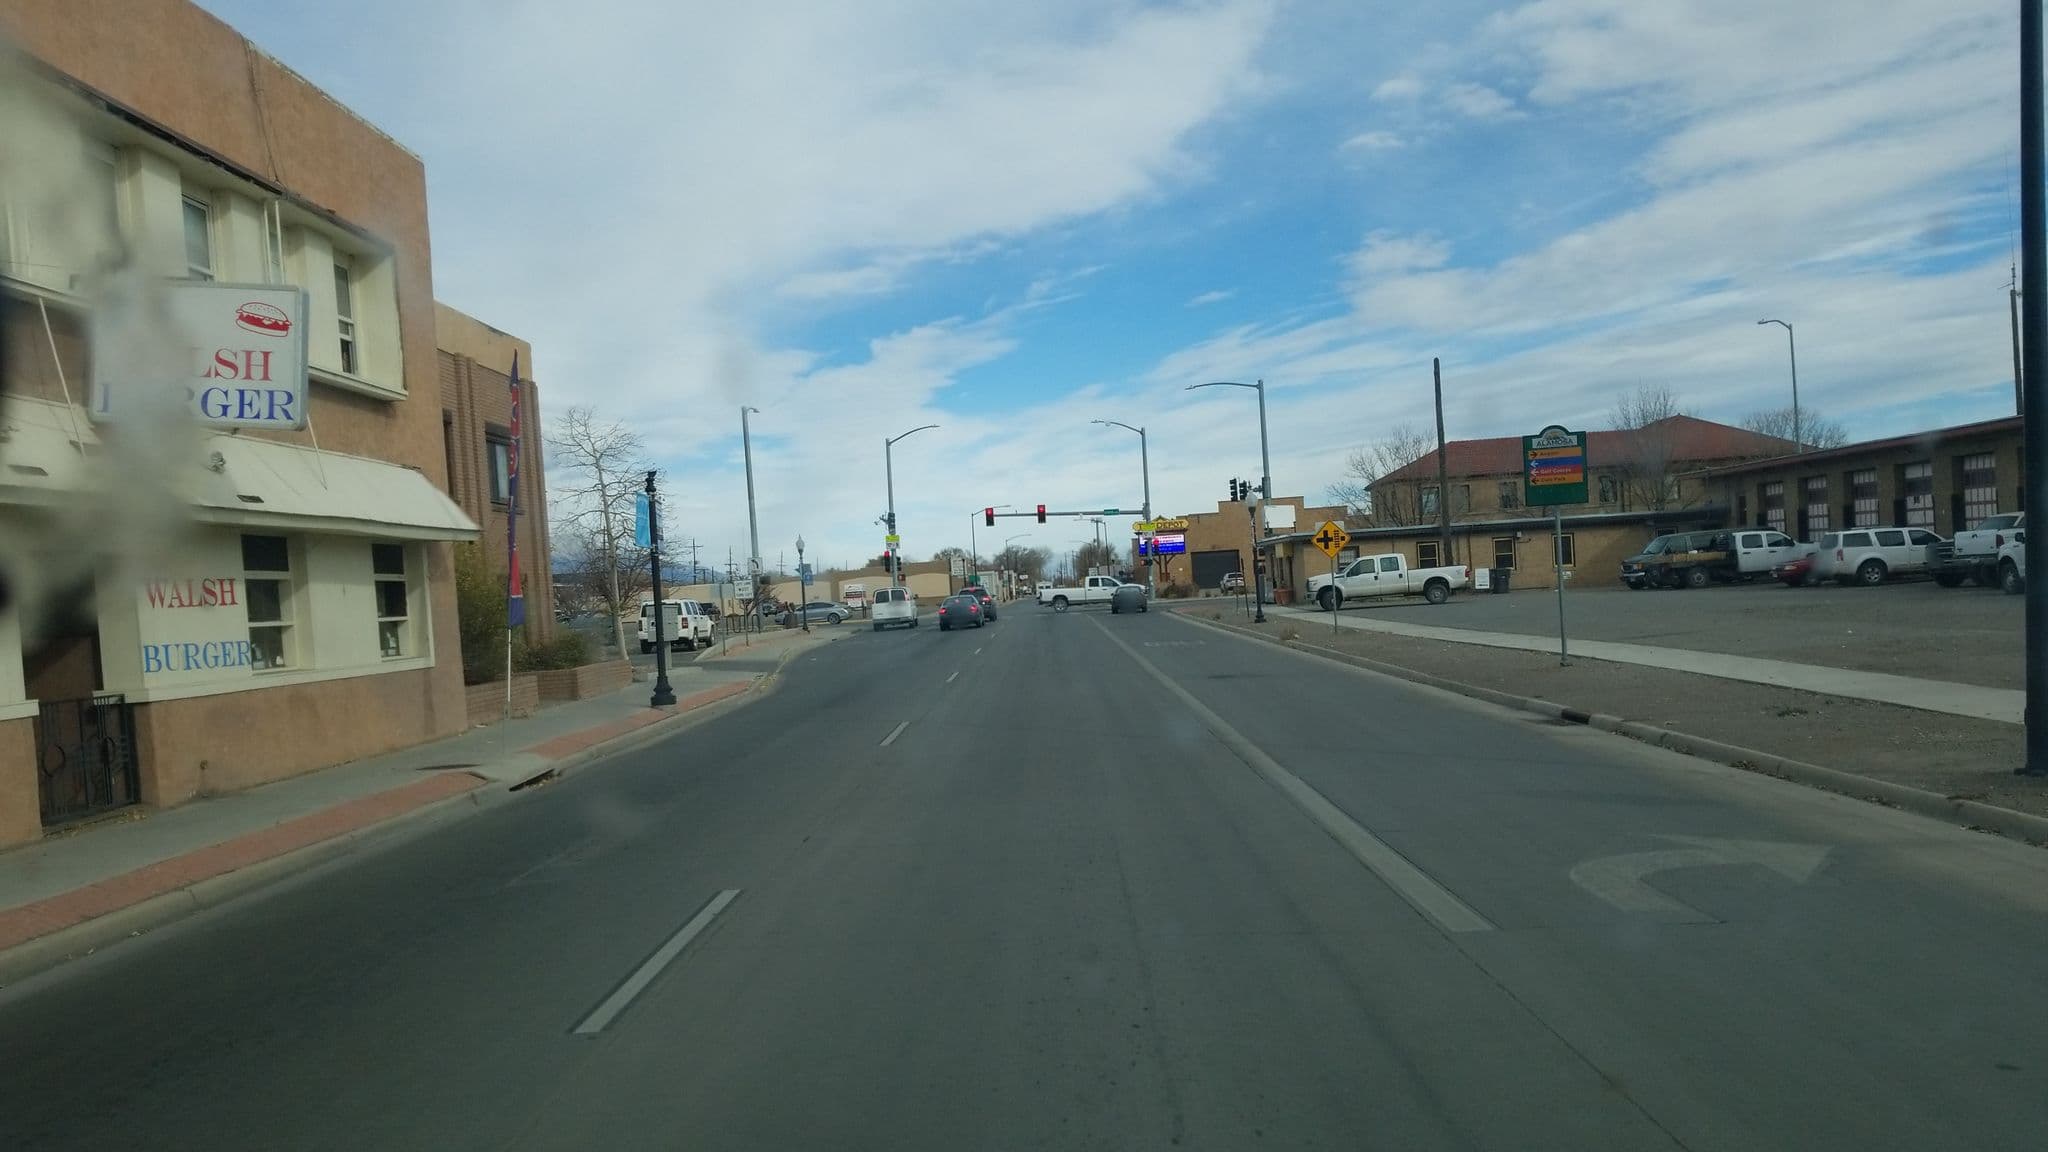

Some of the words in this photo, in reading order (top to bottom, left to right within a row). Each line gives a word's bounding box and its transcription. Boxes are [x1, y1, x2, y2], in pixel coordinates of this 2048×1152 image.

[1156, 520, 1184, 530] DEPOT
[144, 577, 239, 609] WALSH
[143, 640, 252, 673] BURGER
